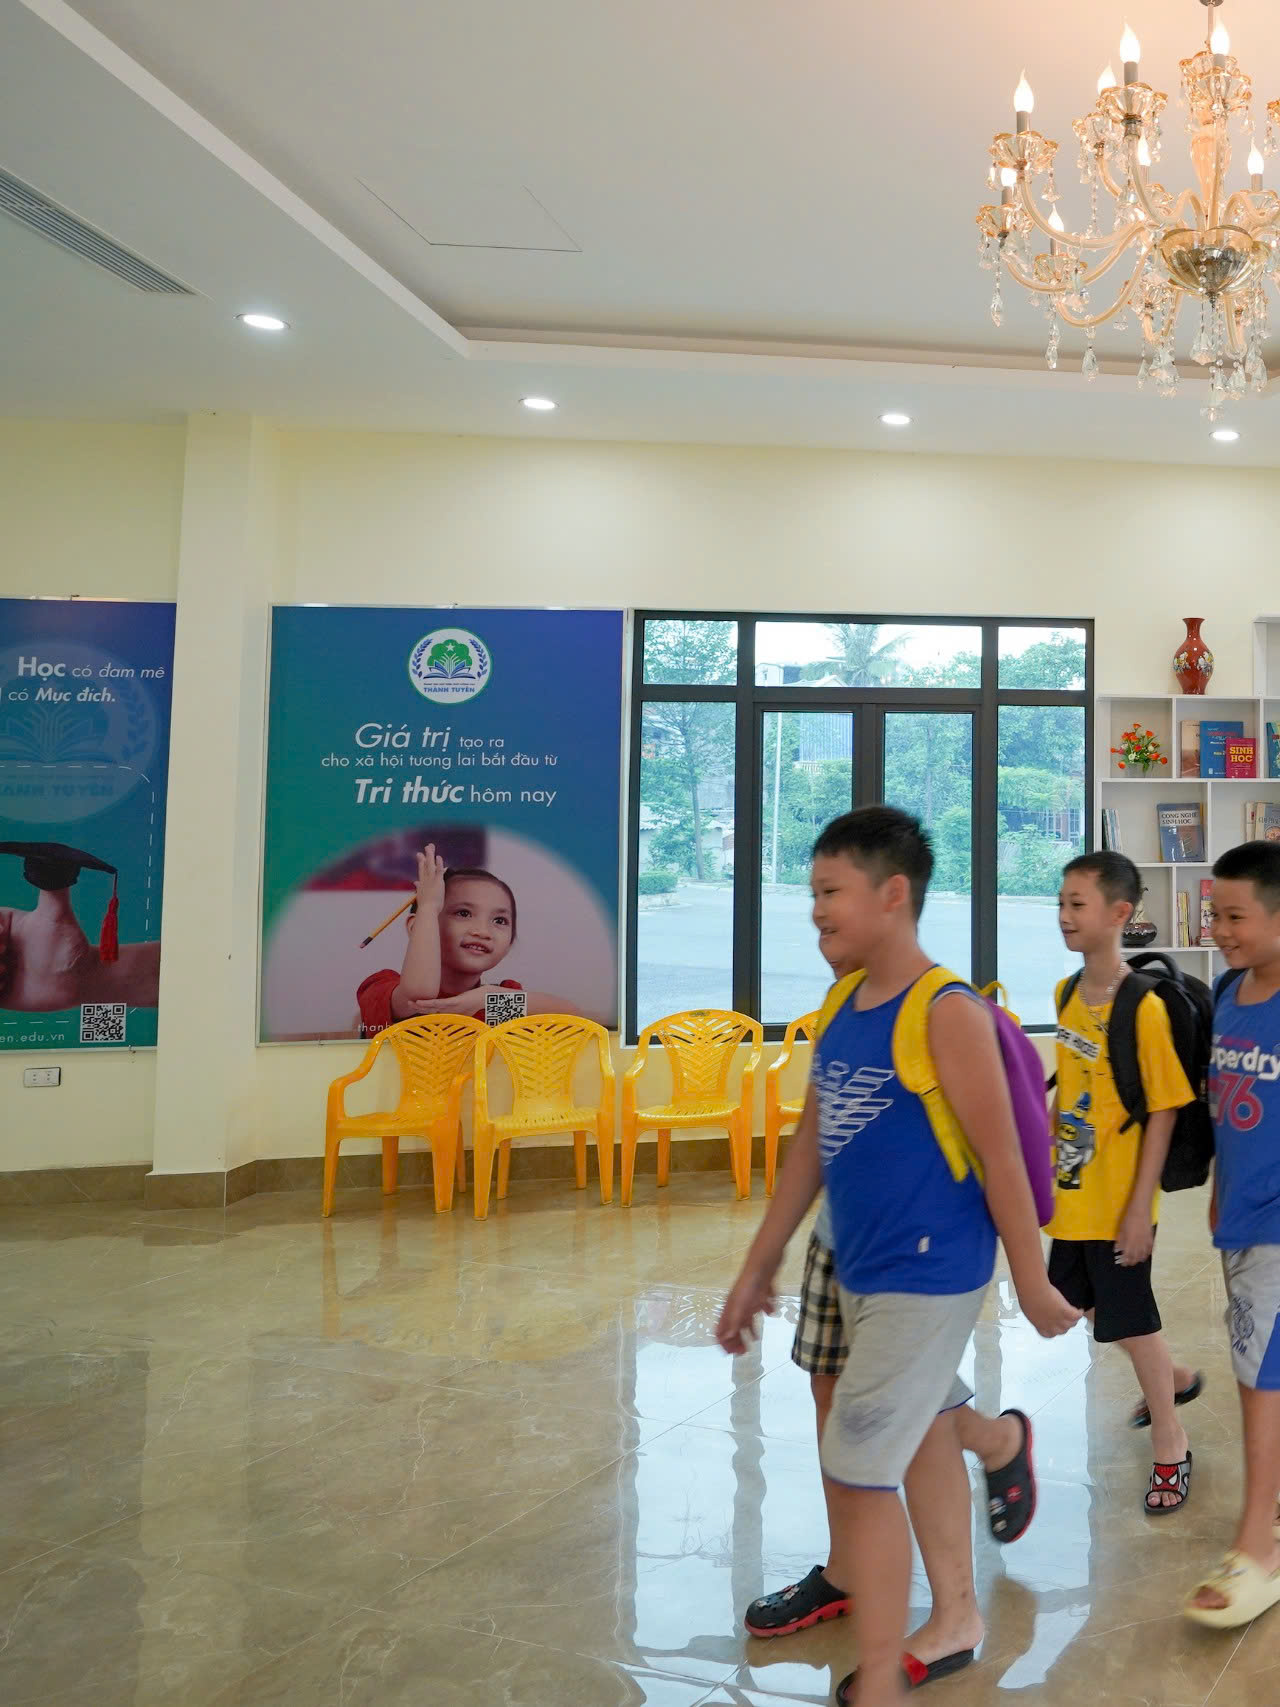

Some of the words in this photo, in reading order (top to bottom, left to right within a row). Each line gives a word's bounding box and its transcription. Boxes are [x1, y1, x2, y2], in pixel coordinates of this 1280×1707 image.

[17, 656, 67, 682] Học
[71, 665, 93, 678] có
[98, 662, 135, 679] đam
[140, 667, 166, 679] mê
[8, 688, 29, 701] có
[35, 687, 72, 704] Mục
[76, 686, 117, 702] đích.
[355, 722, 411, 749] Giá
[422, 726, 452, 753] trị
[459, 736, 484, 750] tạo
[489, 738, 505, 748] ra
[321, 754, 350, 768] cho
[354, 754, 375, 767] xã
[380, 752, 404, 769] hội
[409, 754, 452, 770] tương
[457, 753, 476, 766] lai
[481, 752, 506, 766] bắt
[510, 751, 539, 766] đầu
[544, 754, 559, 766] từ
[1229, 746, 1254, 755] SINH
[354, 777, 394, 804] Tri
[402, 775, 465, 804] thức
[470, 784, 512, 803] hôm
[520, 789, 558, 807] nay
